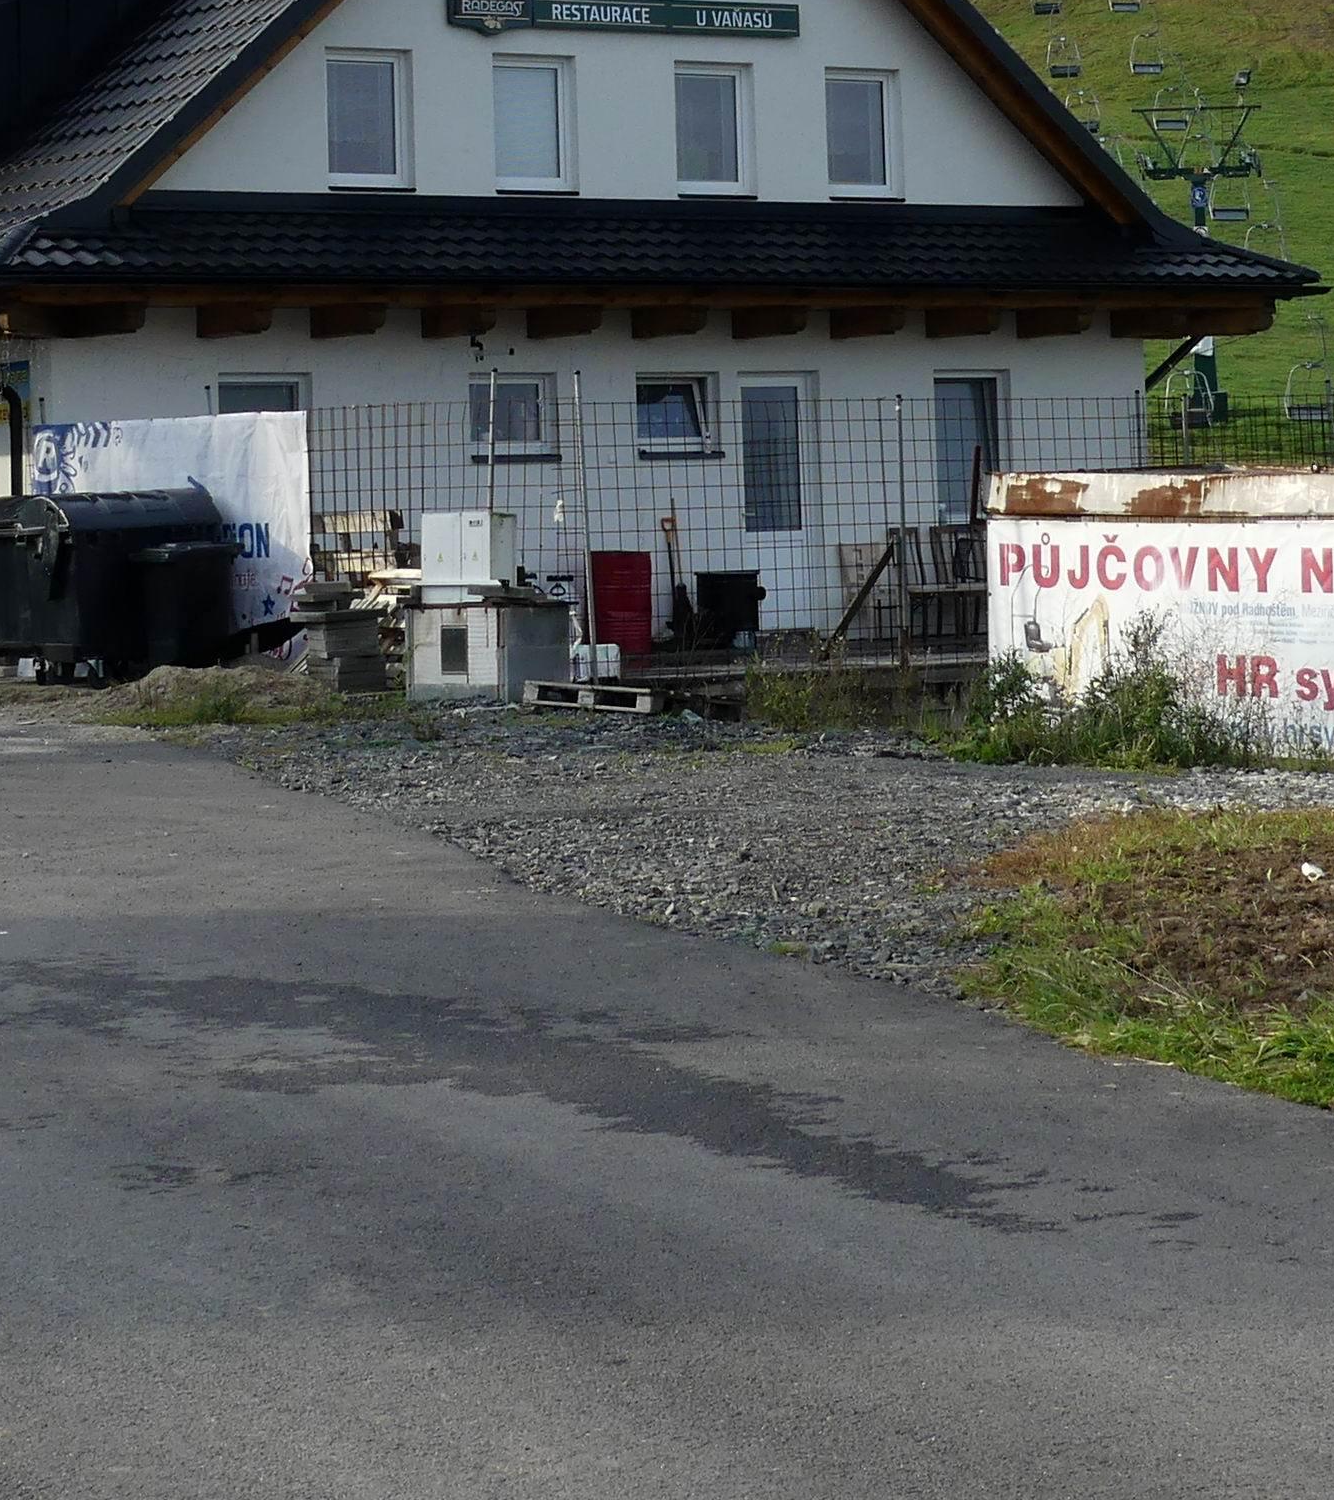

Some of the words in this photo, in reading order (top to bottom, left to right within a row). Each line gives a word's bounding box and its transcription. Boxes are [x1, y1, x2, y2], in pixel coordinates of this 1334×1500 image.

[461, 0, 525, 17] RADEGAST
[551, 3, 651, 25] RESTAURACE
[696, 10, 706, 26] U
[712, 7, 773, 30] VAŇASŮ
[998, 532, 1279, 594] PŮJČOVNY
[1221, 602, 1240, 618] pod
[1215, 653, 1280, 699] HR
